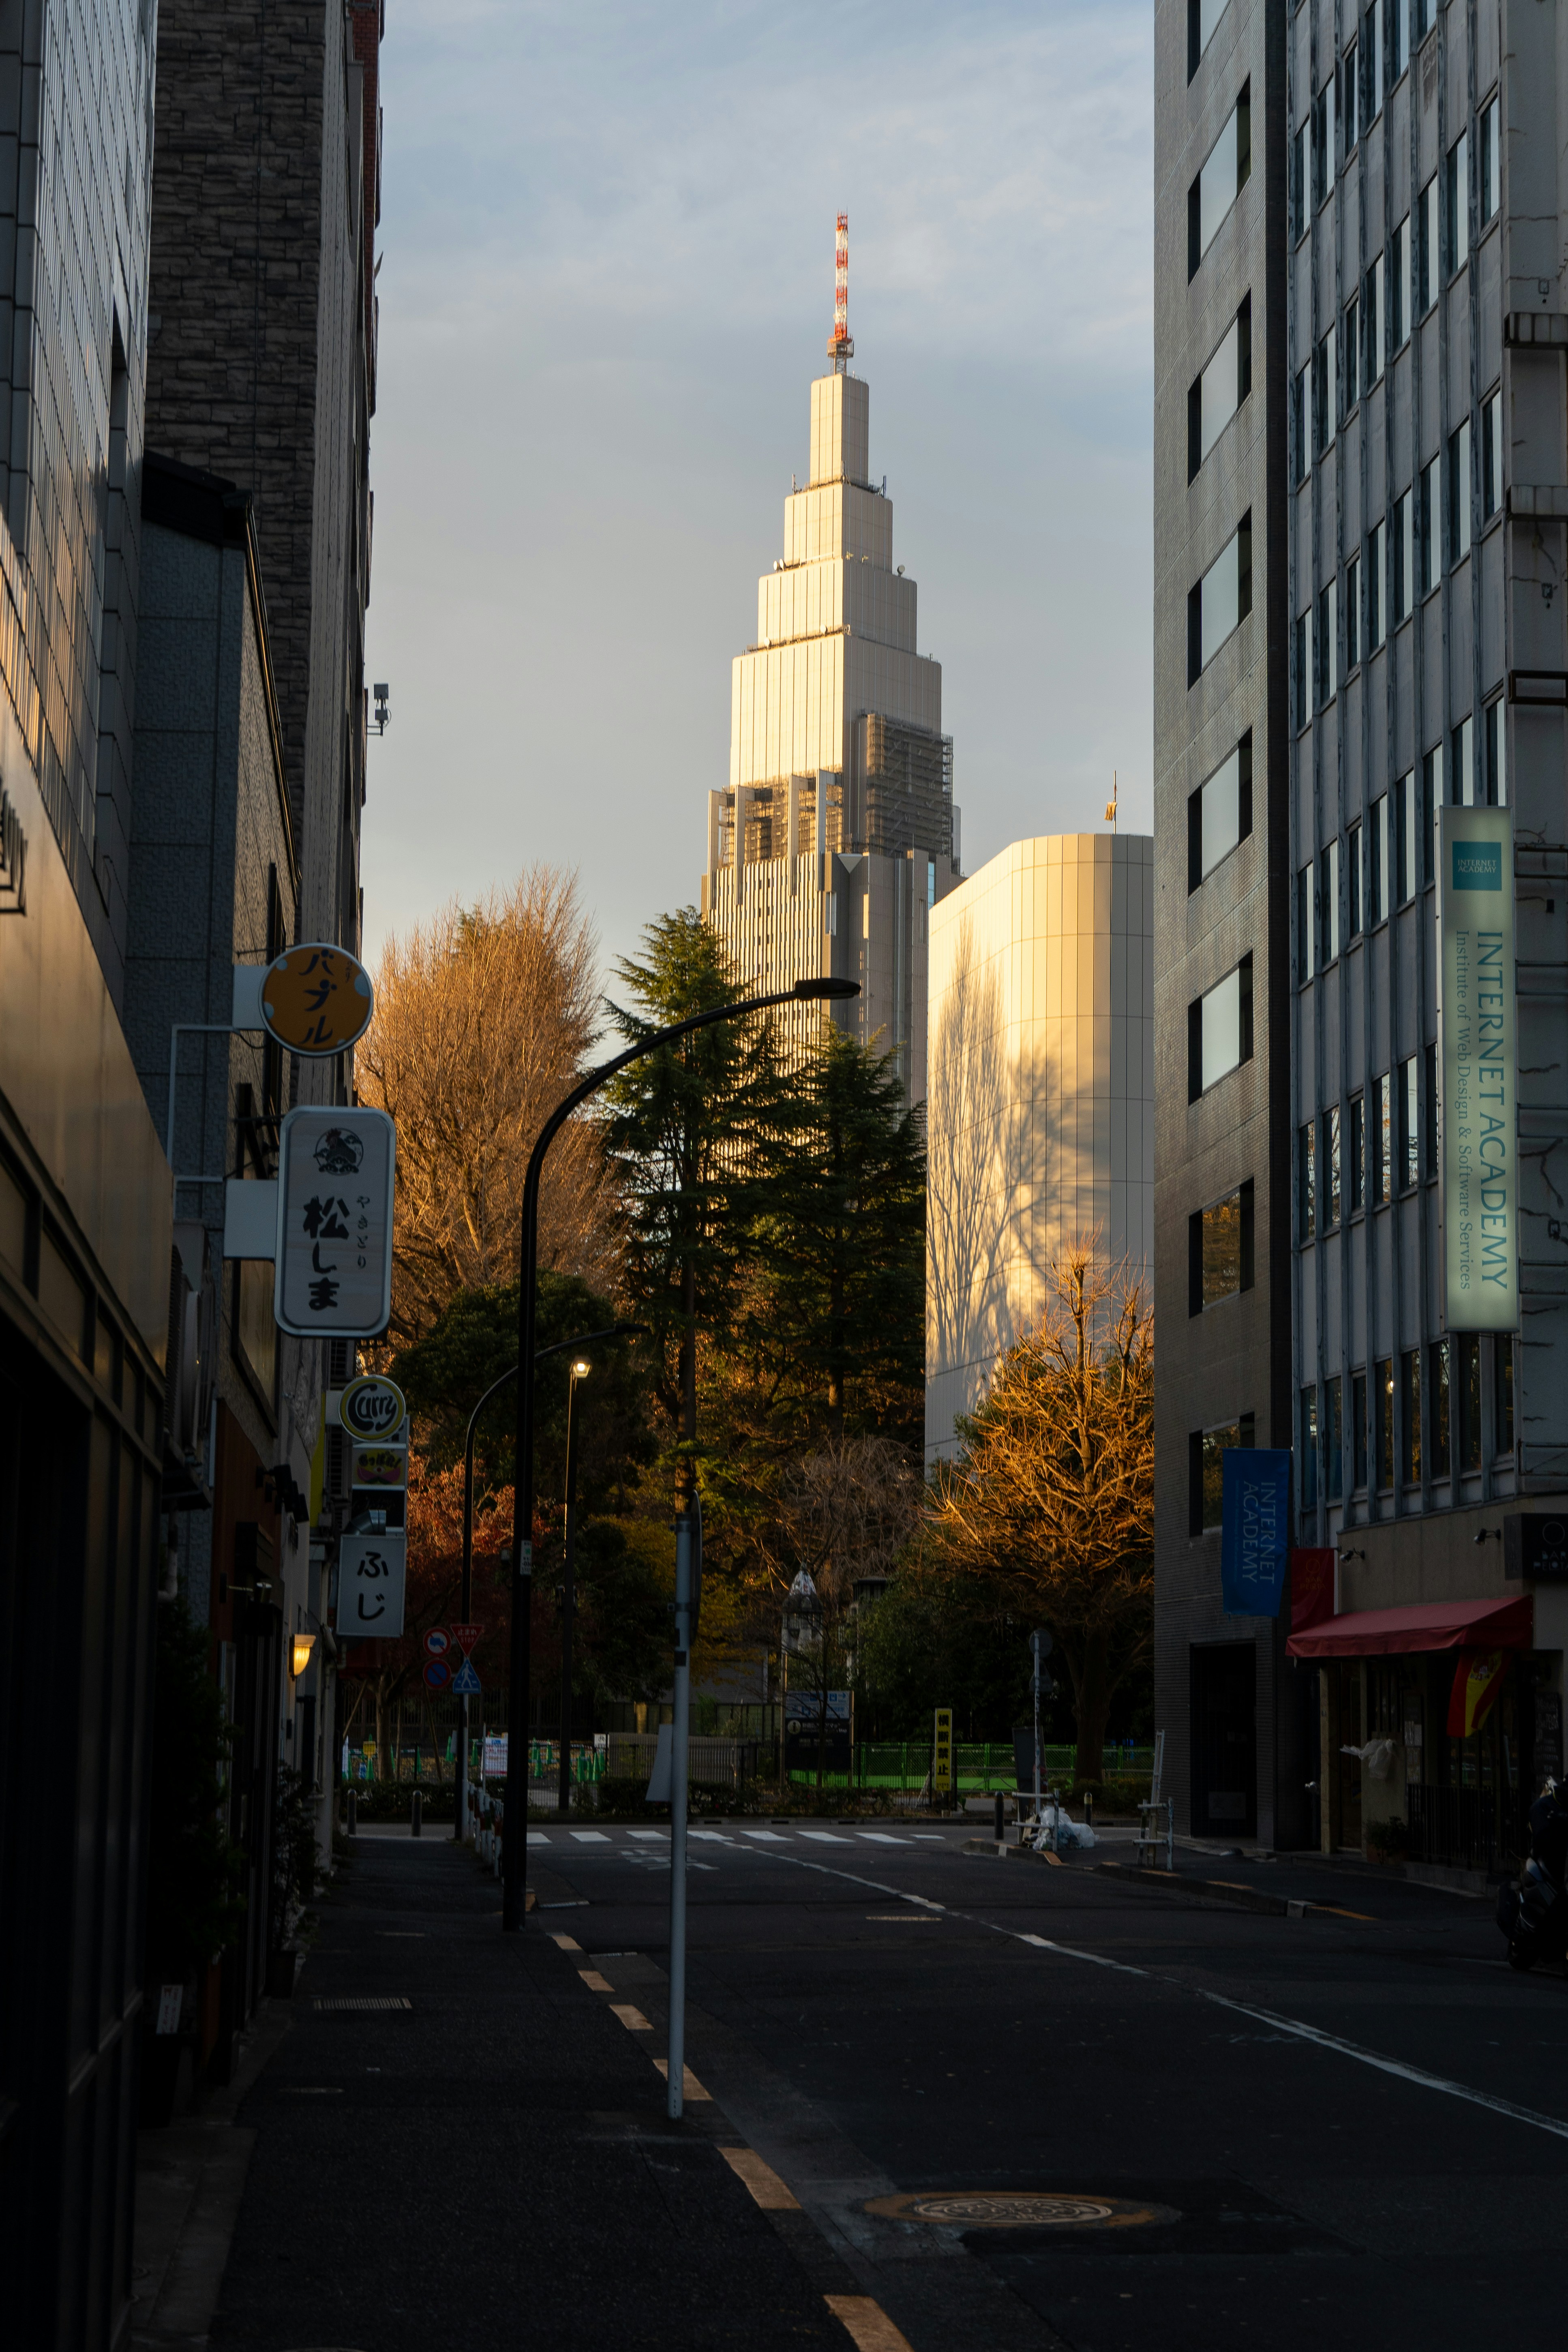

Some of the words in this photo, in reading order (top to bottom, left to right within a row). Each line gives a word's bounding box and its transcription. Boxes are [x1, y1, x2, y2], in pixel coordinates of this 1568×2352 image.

[299, 949, 337, 1045] バブル
[1456, 930, 1470, 998] Institute
[1457, 1004, 1470, 1021] of
[1458, 1027, 1471, 1061] Web
[1477, 931, 1505, 1106] INTERNET
[1454, 1065, 1471, 1120] Design
[1459, 1127, 1472, 1139] &
[1459, 1146, 1472, 1217] Software
[1479, 1112, 1507, 1290] ACADEMY
[303, 1195, 350, 1311] 松しま
[356, 1196, 370, 1269] やきとり
[1459, 1222, 1474, 1290] Services
[348, 1384, 397, 1431] Curry
[1242, 1480, 1259, 1583] ACADEMY
[1260, 1482, 1276, 1584] INTERNET
[1542, 1550, 1567, 1560] BAR
[357, 1551, 389, 1620] ふじ
[938, 1714, 949, 1776] 横断禁止
